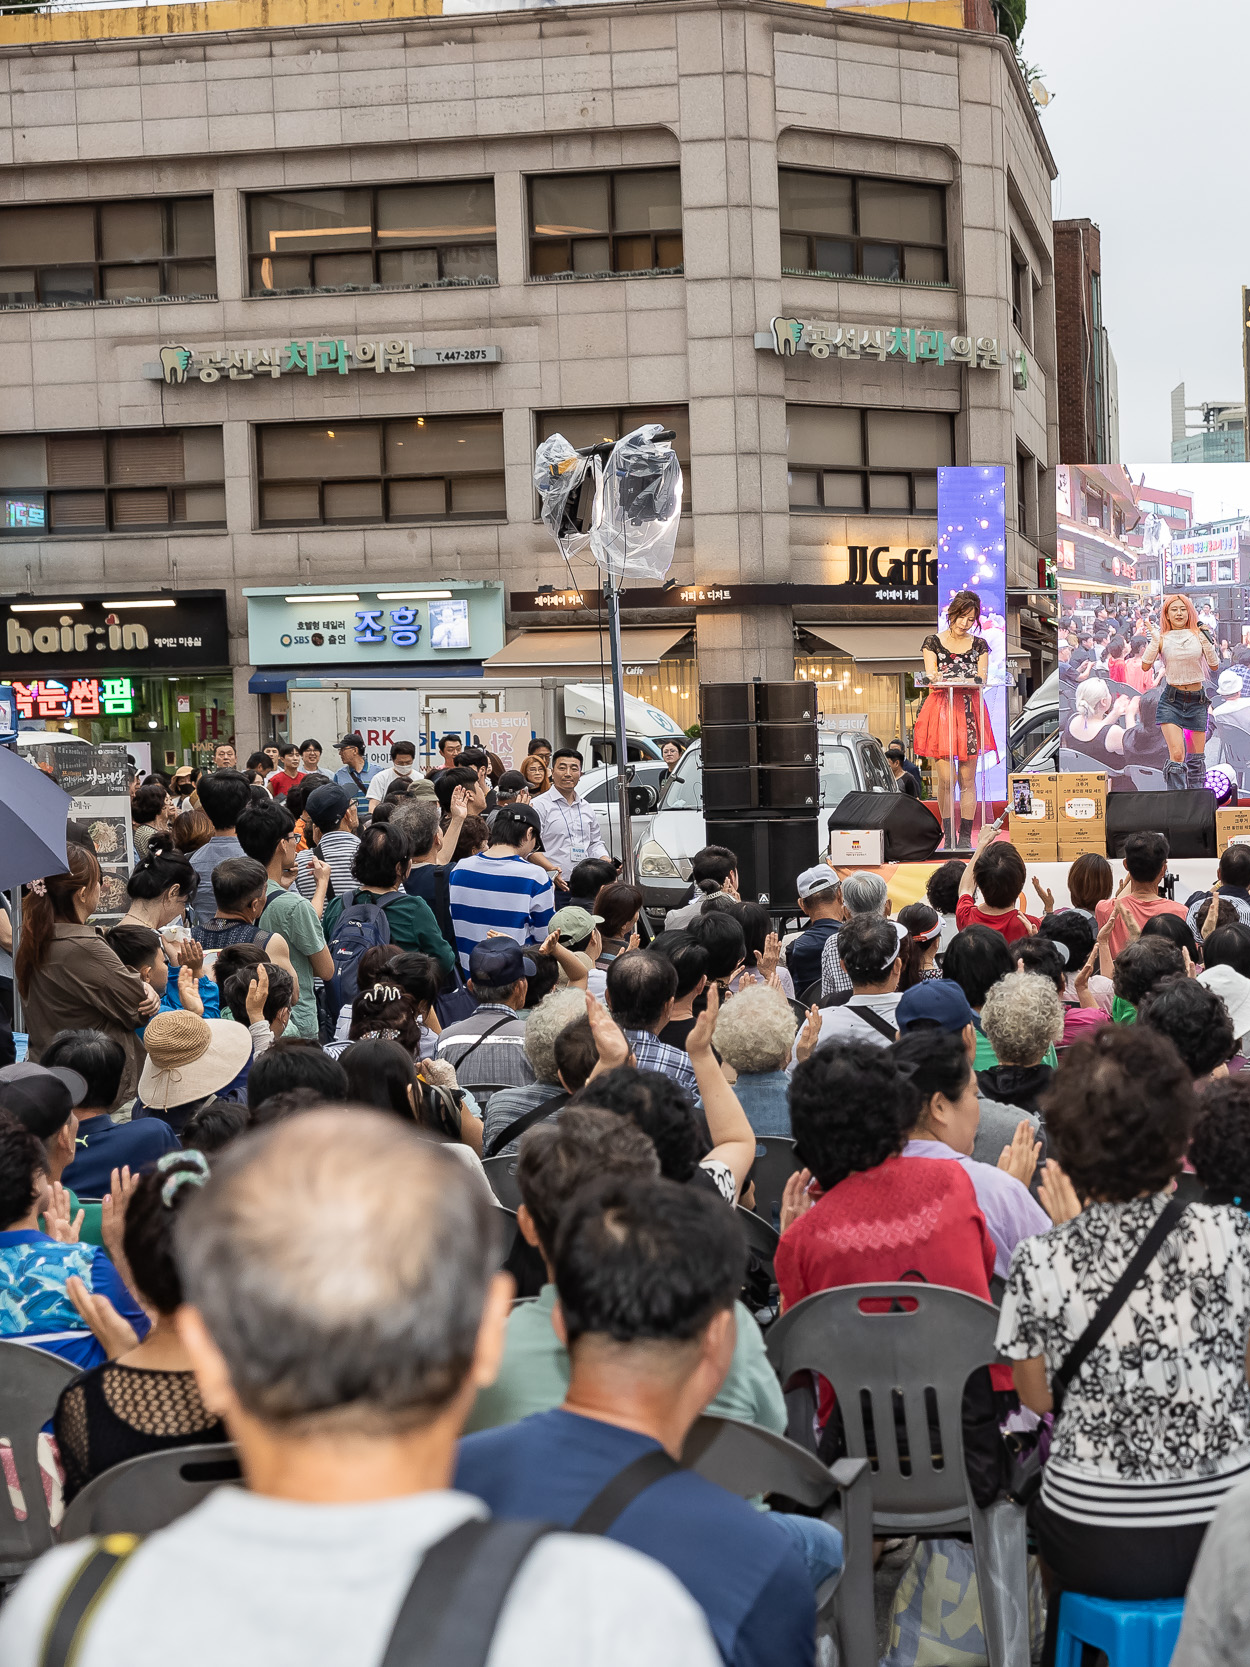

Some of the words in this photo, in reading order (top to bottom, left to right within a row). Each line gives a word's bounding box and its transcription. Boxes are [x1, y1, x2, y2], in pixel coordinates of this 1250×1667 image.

[680, 591, 697, 601] 커피
[707, 590, 731, 600] 디저트
[354, 606, 422, 646] 조흥
